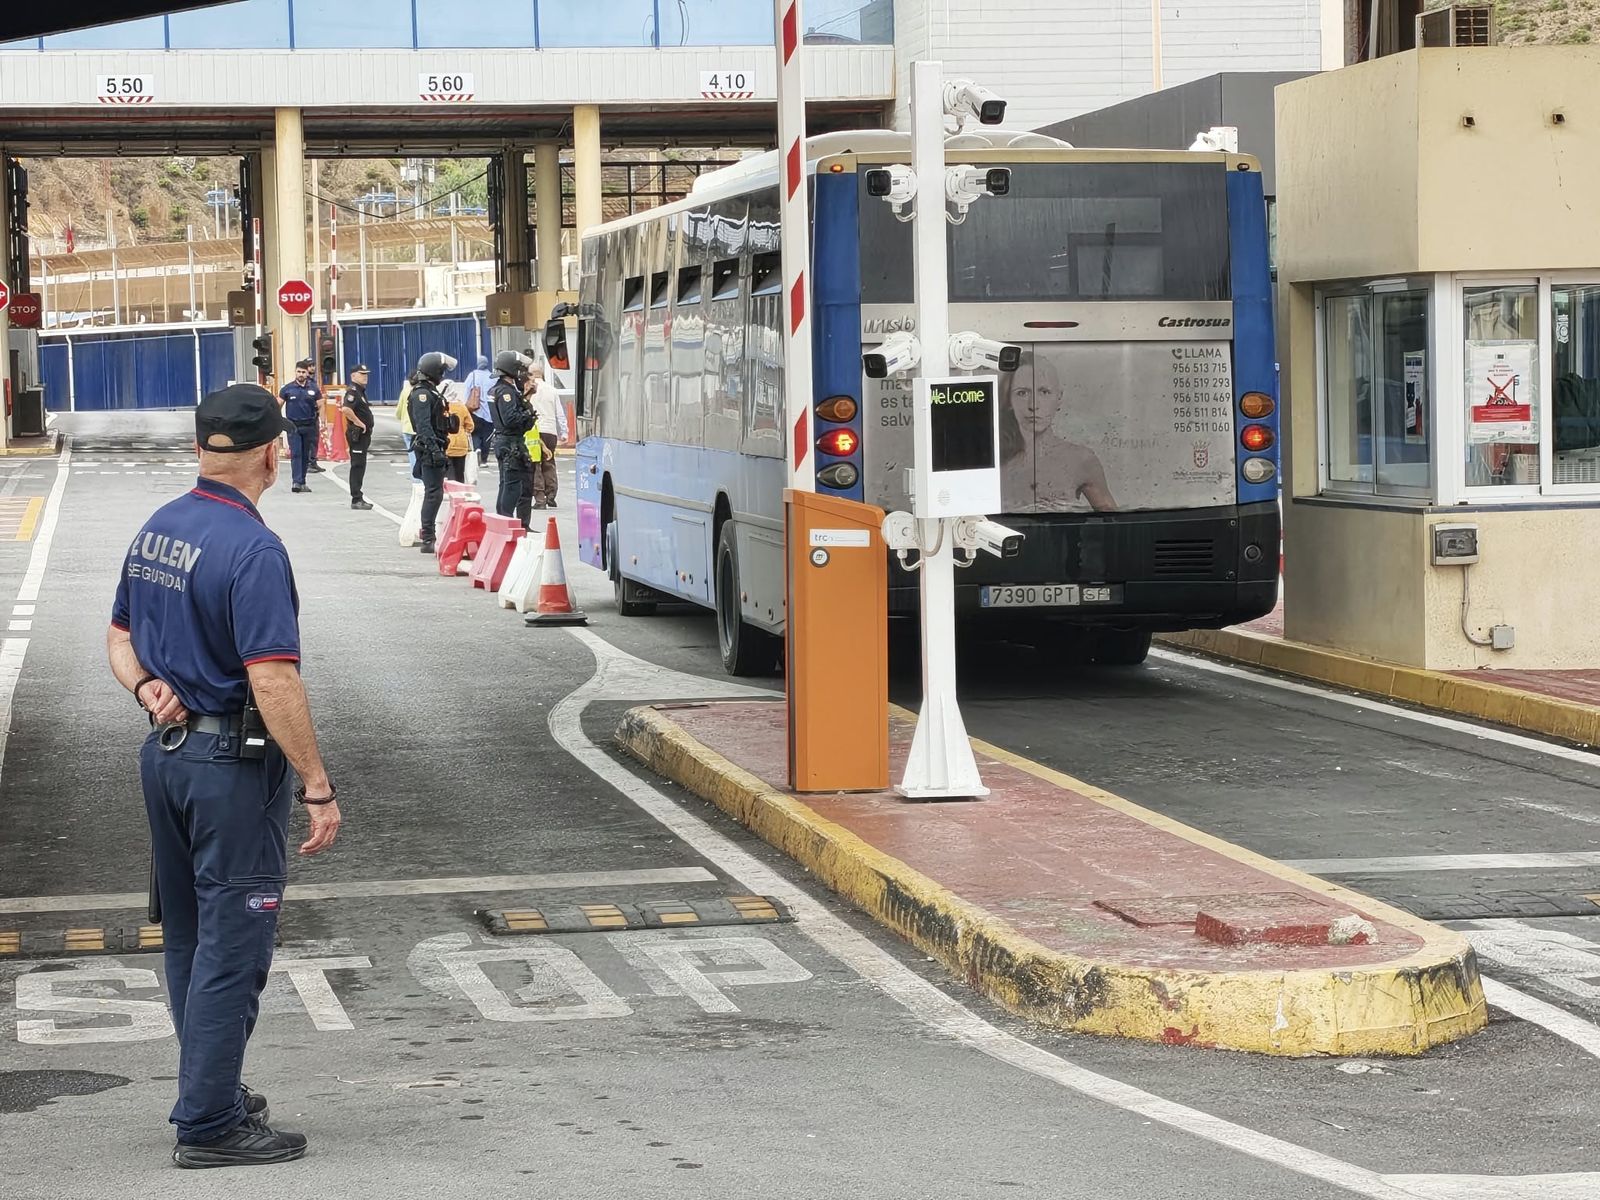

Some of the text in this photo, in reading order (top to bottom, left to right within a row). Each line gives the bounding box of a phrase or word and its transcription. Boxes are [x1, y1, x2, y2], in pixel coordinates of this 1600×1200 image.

[281, 293, 311, 302] STOP
[10, 306, 37, 314] STOP
[1158, 316, 1231, 327] Castrosua
[1184, 348, 1222, 359] LLAMA
[1172, 363, 1227, 373] 956 513 715
[1173, 378, 1230, 388] 956 519 293
[930, 387, 985, 405] Welcome
[1173, 393, 1231, 403] 956 510 469
[880, 397, 898, 408] es
[1173, 408, 1228, 417] 956 511 814
[1174, 422, 1230, 432] 956 511 060
[992, 588, 1036, 604] 7390
[1042, 587, 1074, 603] GPT
